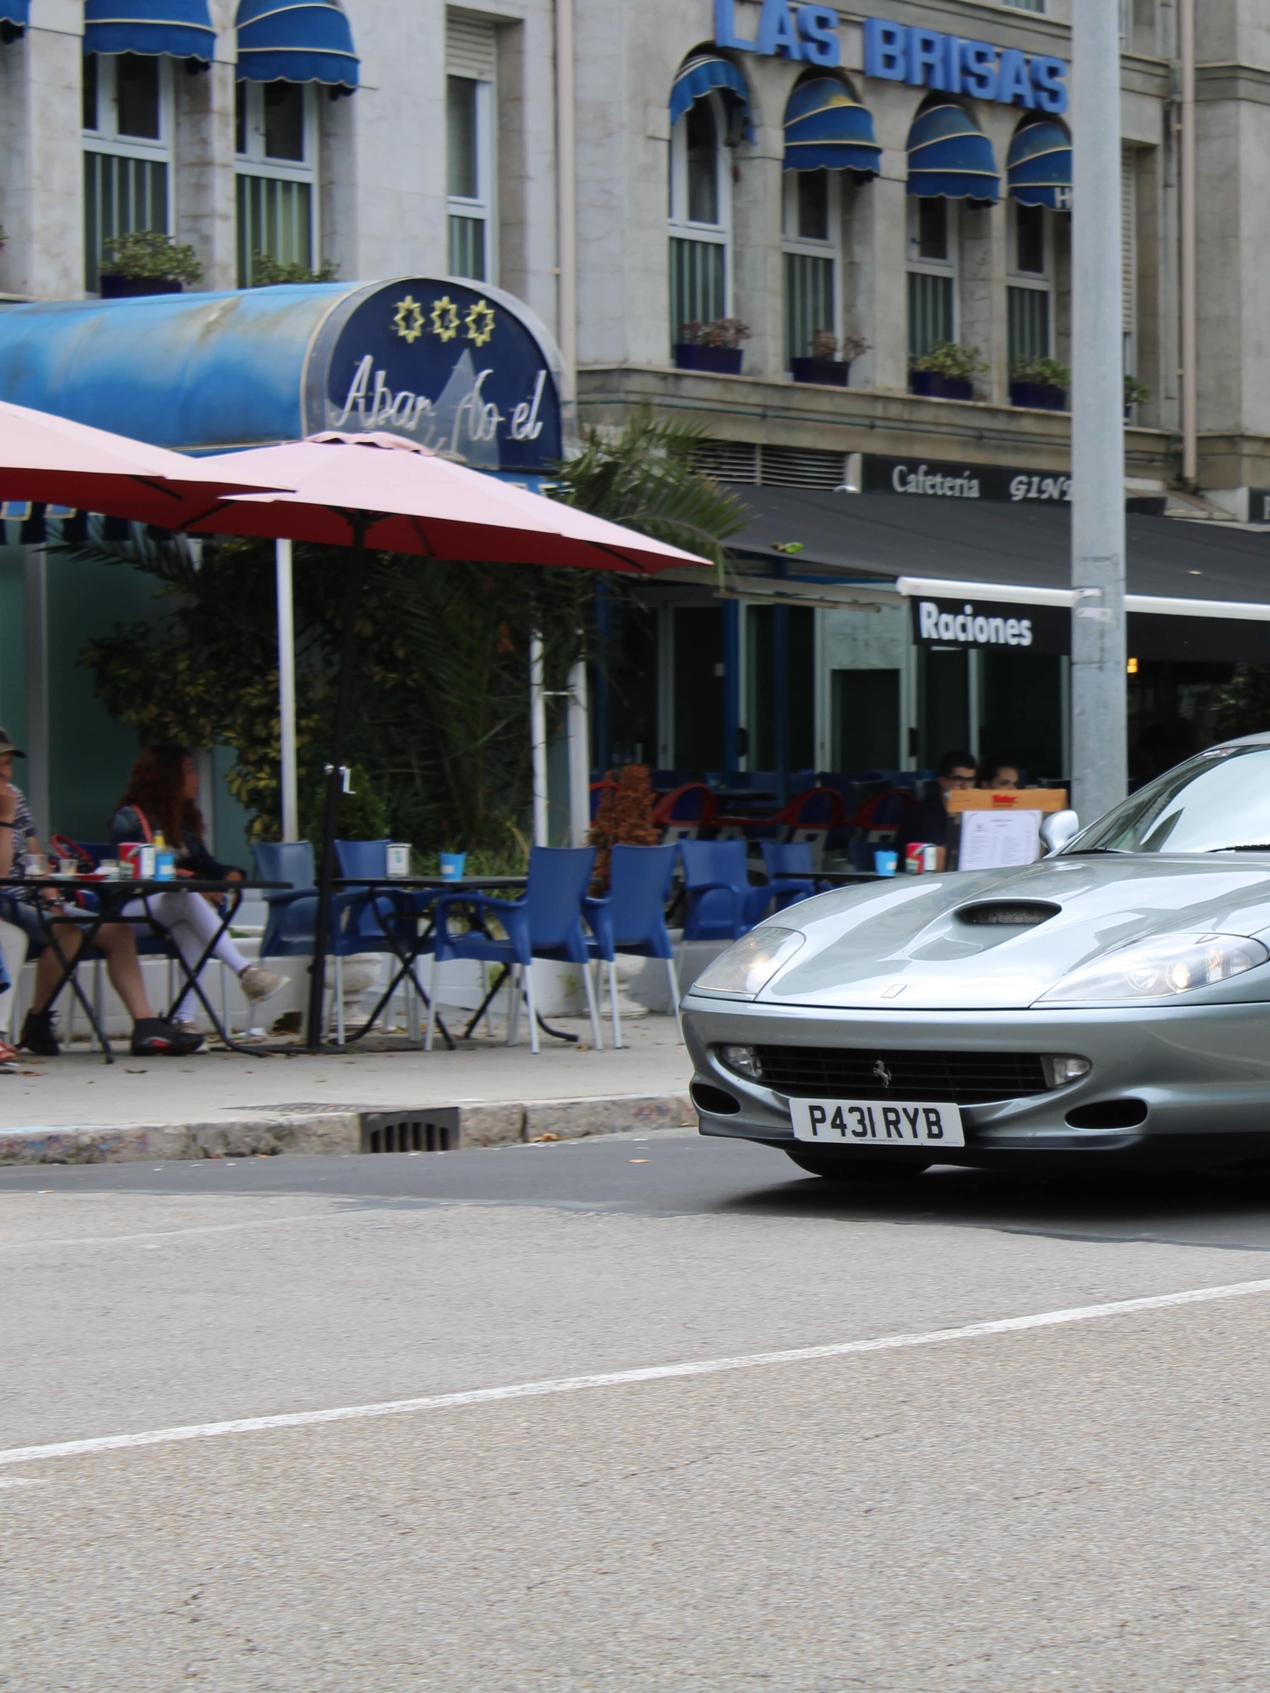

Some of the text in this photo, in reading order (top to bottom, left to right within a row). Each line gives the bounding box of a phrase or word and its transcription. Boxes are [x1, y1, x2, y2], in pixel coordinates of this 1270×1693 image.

[714, 0, 1068, 115] LAS BRISAS
[892, 465, 980, 498] Cafetería
[919, 602, 1033, 647] Raciones
[808, 1105, 944, 1140] P431 RYB
